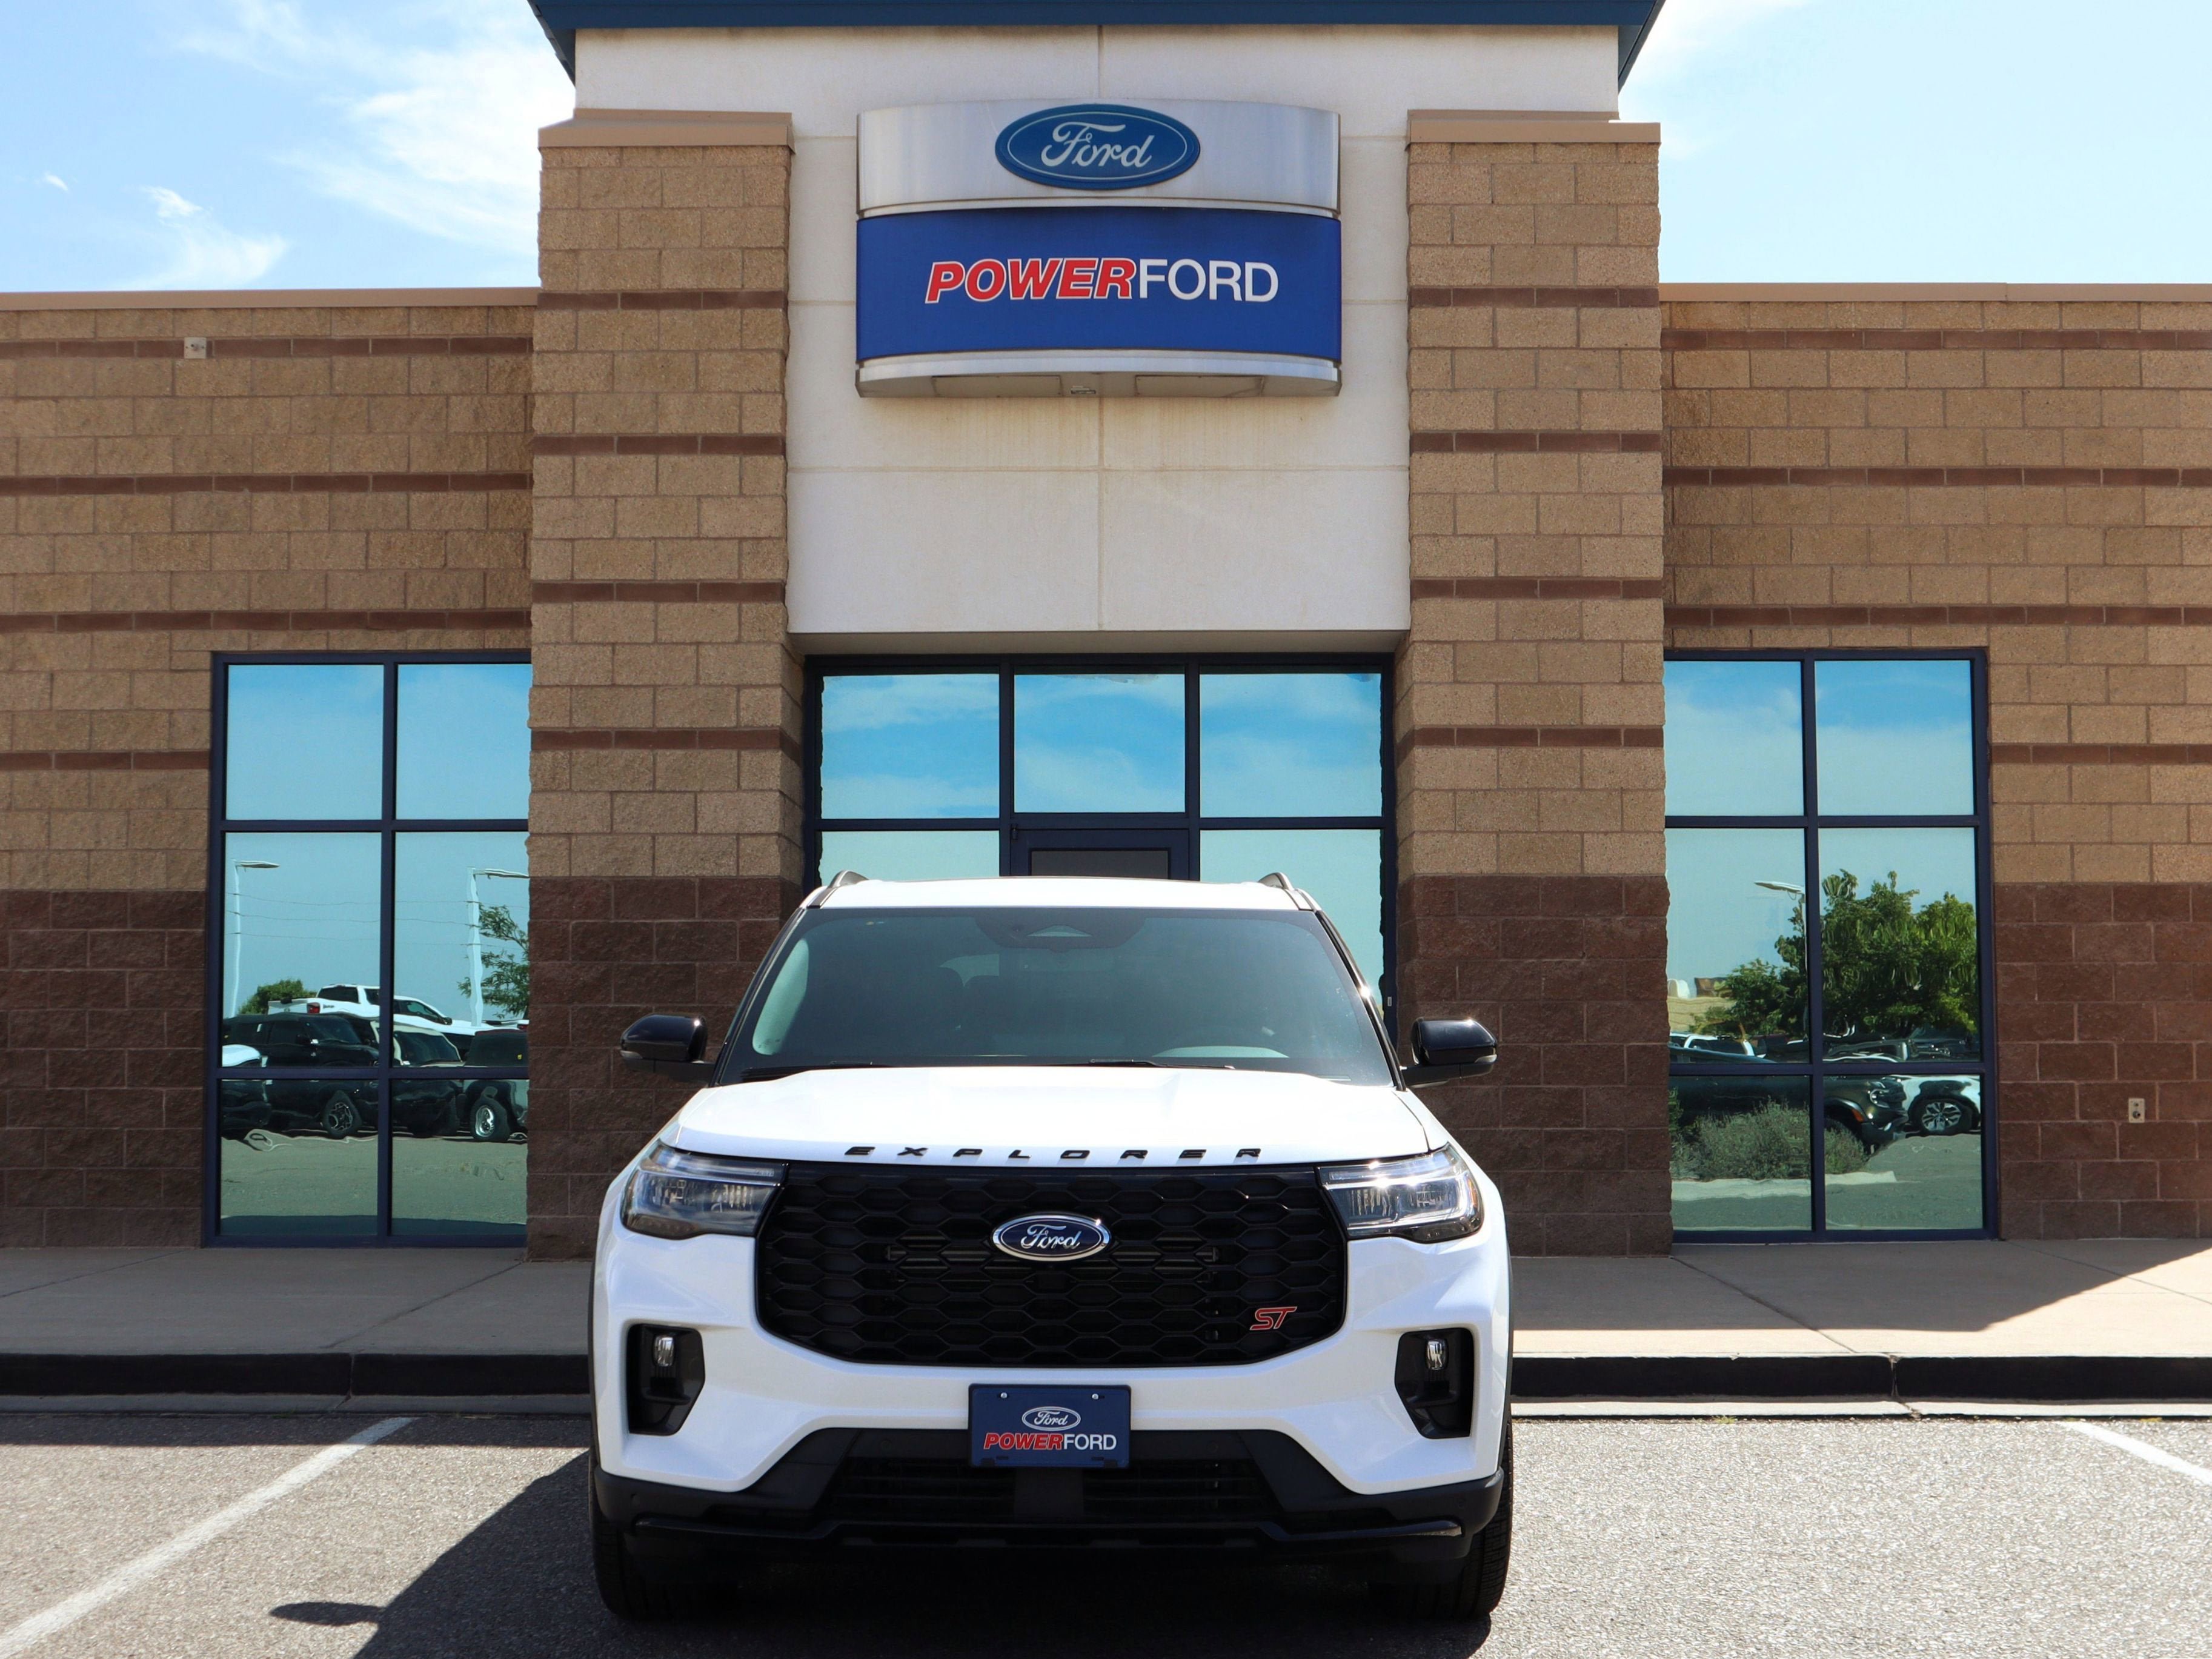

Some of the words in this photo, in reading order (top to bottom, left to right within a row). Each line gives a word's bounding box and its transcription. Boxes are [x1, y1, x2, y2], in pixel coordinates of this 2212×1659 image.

[1040, 121, 1154, 167] Ford
[925, 258, 1279, 304] POWERFORD
[844, 1146, 1262, 1160] EXPLORER
[1020, 1224, 1082, 1249] Ford
[1249, 1306, 1298, 1331] ST
[1034, 1411, 1068, 1426] Ford
[983, 1432, 1117, 1451] POWERFORD
